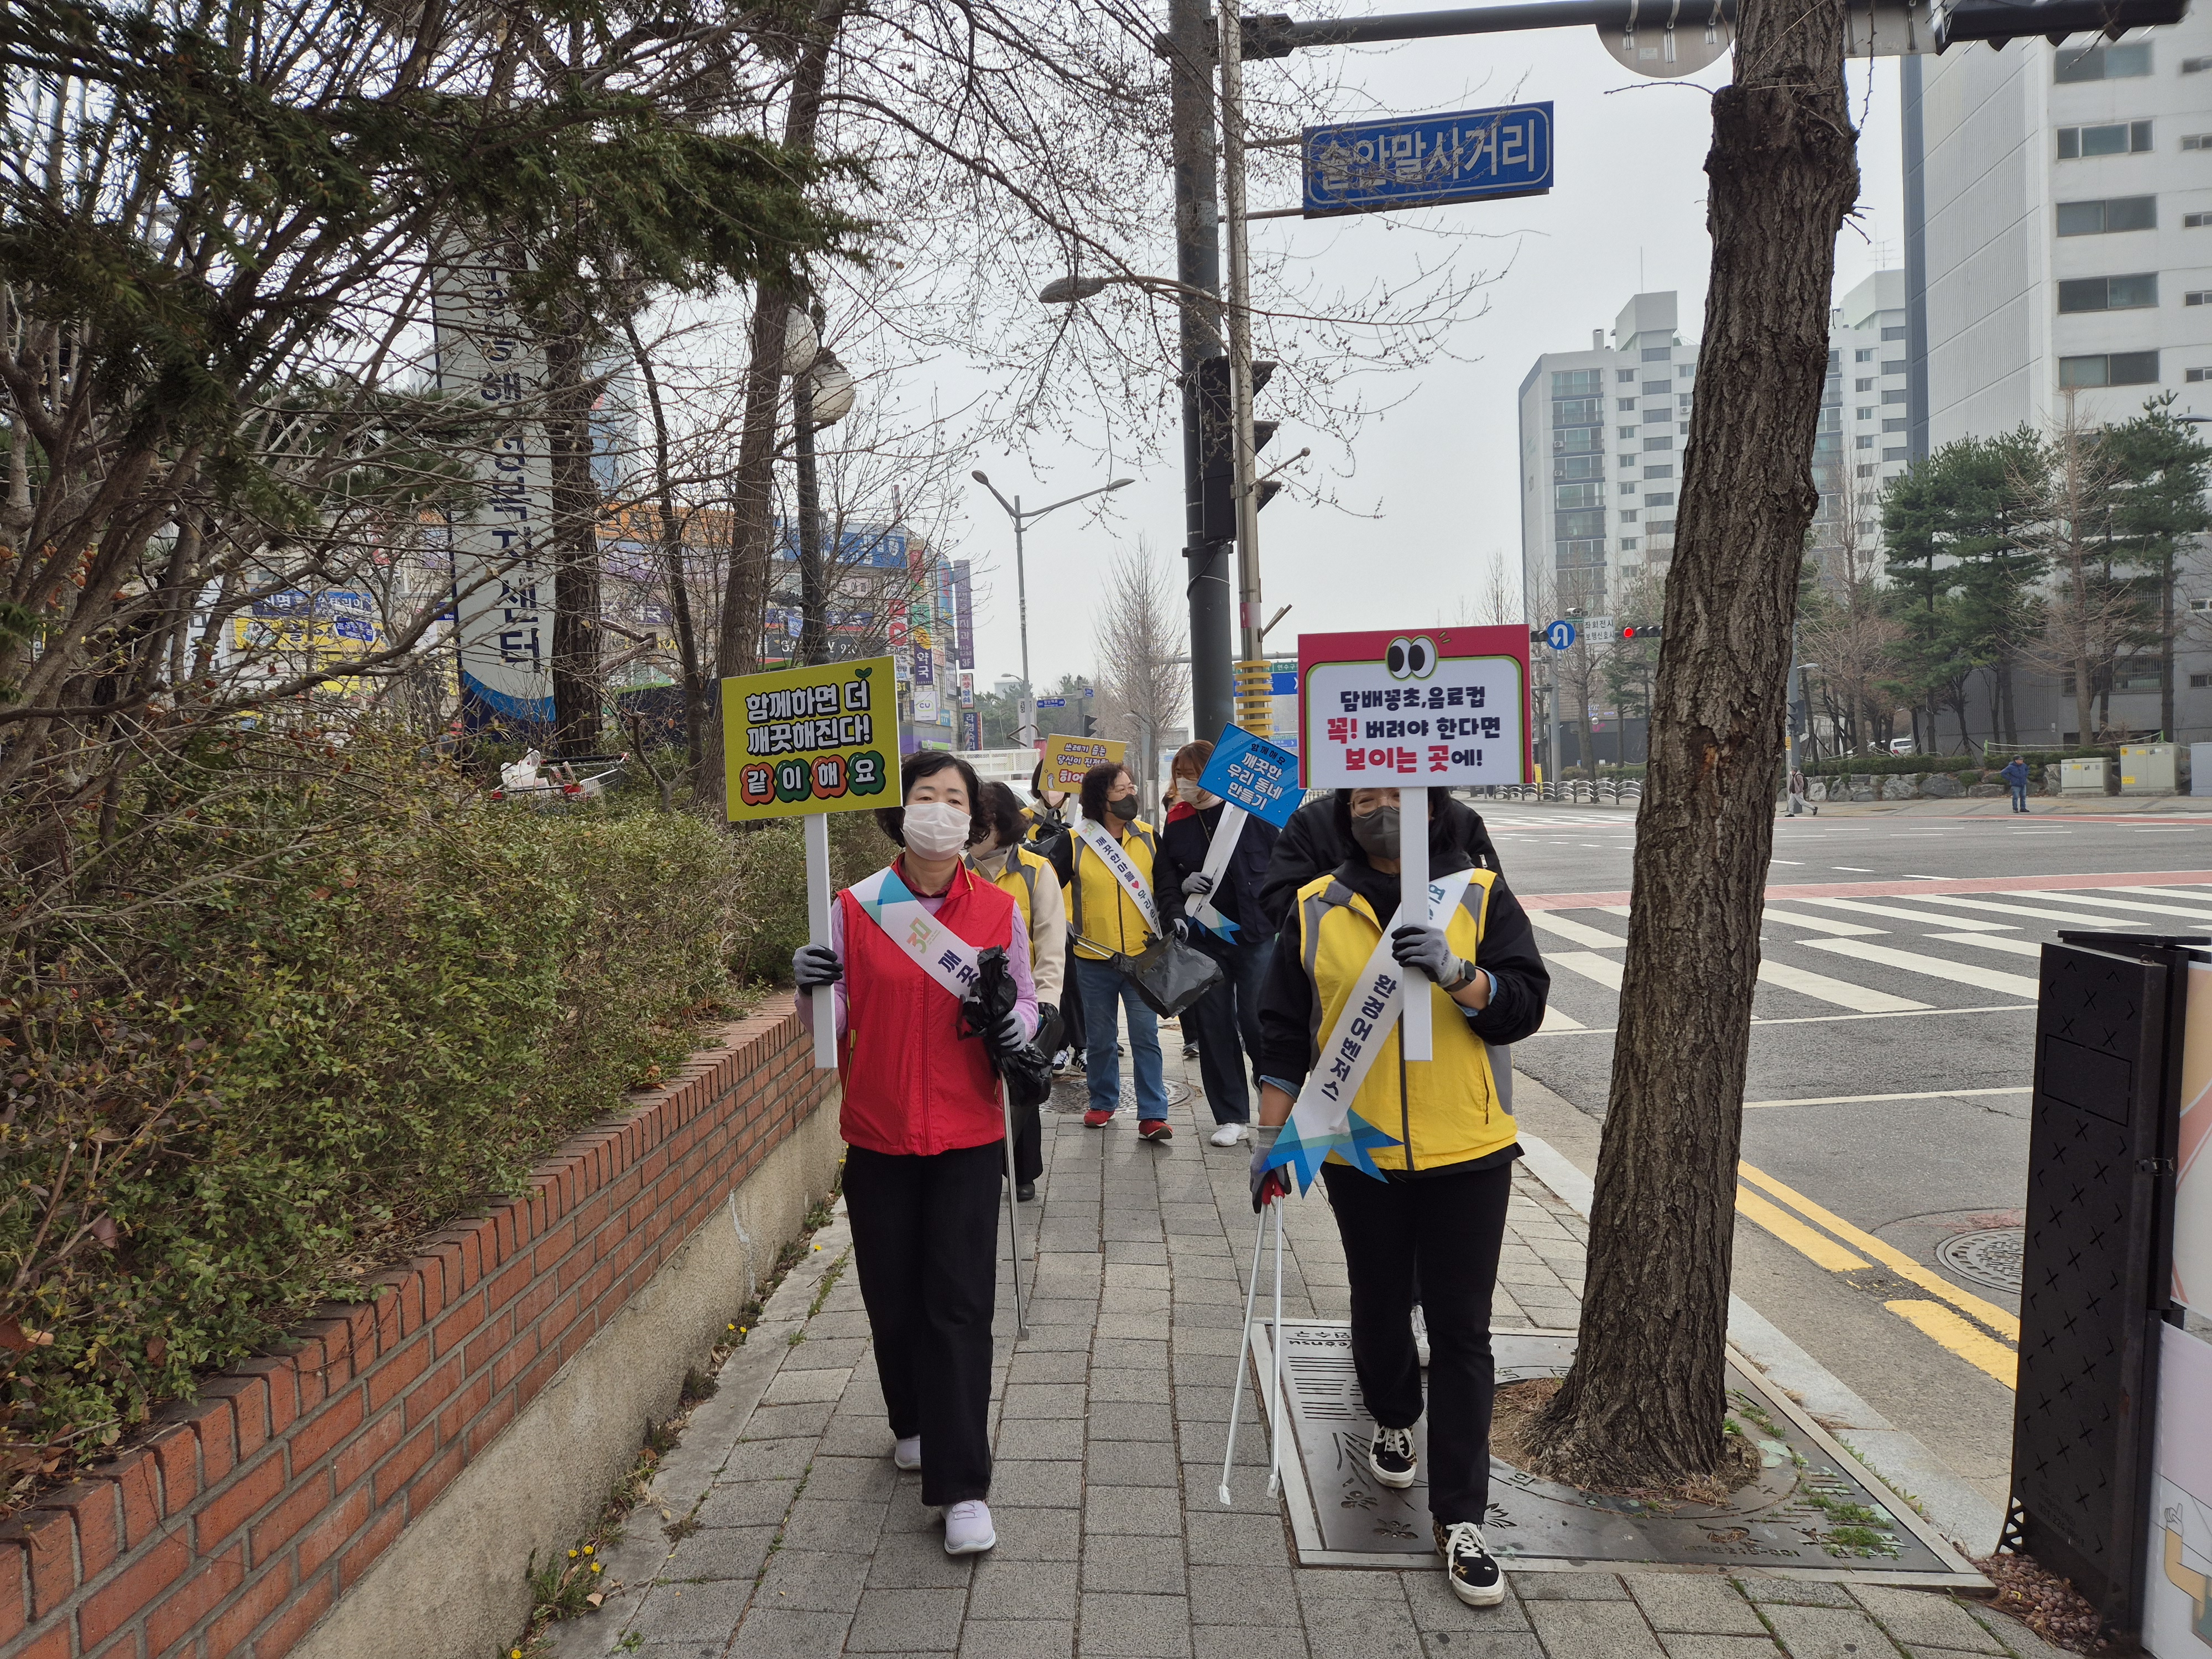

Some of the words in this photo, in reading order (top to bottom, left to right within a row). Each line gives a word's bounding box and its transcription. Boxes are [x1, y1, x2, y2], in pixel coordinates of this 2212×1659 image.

[1584, 619, 1614, 629] 좌회전시
[1585, 630, 1615, 641] 보행신호시
[916, 651, 930, 679] 약국
[962, 658, 971, 667] 3F
[745, 683, 841, 724] 함께하면
[844, 679, 871, 712] 더
[1340, 686, 1486, 712] 담배꽁초,음료컵
[746, 713, 873, 756] 깨끗해진다!
[1327, 717, 1358, 745] 꼭!
[1365, 719, 1429, 739] 버려야
[1436, 717, 1501, 740] 한다면
[1056, 754, 1082, 765] 당신이
[1064, 742, 1089, 753] 쓰레기
[1091, 744, 1107, 757] 줍는
[1345, 746, 1417, 774] 보이는
[1427, 744, 1483, 773] 곳에!
[1240, 752, 1283, 781] 깨끗한
[1226, 763, 1255, 786] 우리
[1253, 776, 1284, 801] 동네
[1227, 780, 1269, 812] 만들기
[1321, 973, 1398, 1103] 환경어벤저스
